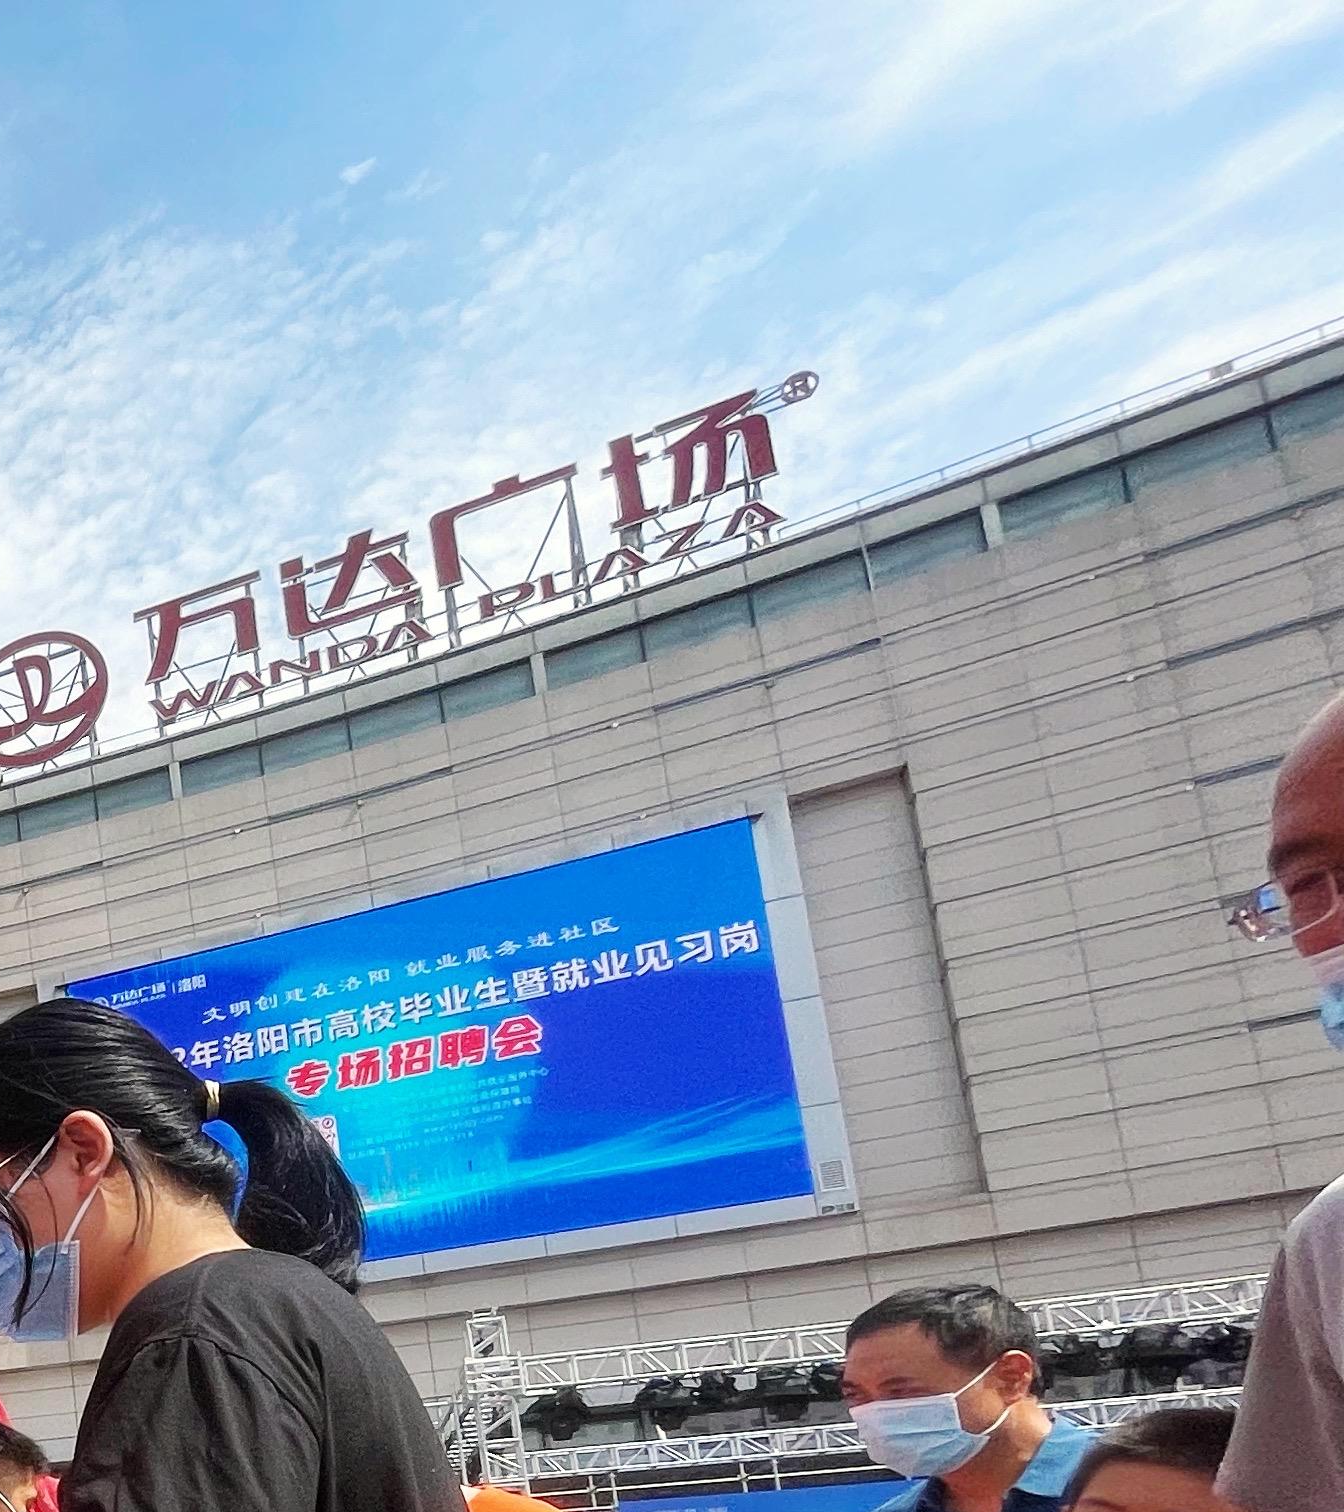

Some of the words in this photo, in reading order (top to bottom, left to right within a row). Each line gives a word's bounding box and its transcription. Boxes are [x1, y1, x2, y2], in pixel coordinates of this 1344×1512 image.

[134, 388, 779, 686] 万达广场
[148, 617, 434, 724] WANDA
[479, 500, 788, 620] PLAZA
[201, 966, 392, 1024] 文明创建在洛阳
[406, 916, 620, 977] 就业服务进社区
[285, 1014, 543, 1098] 专场招聘会
